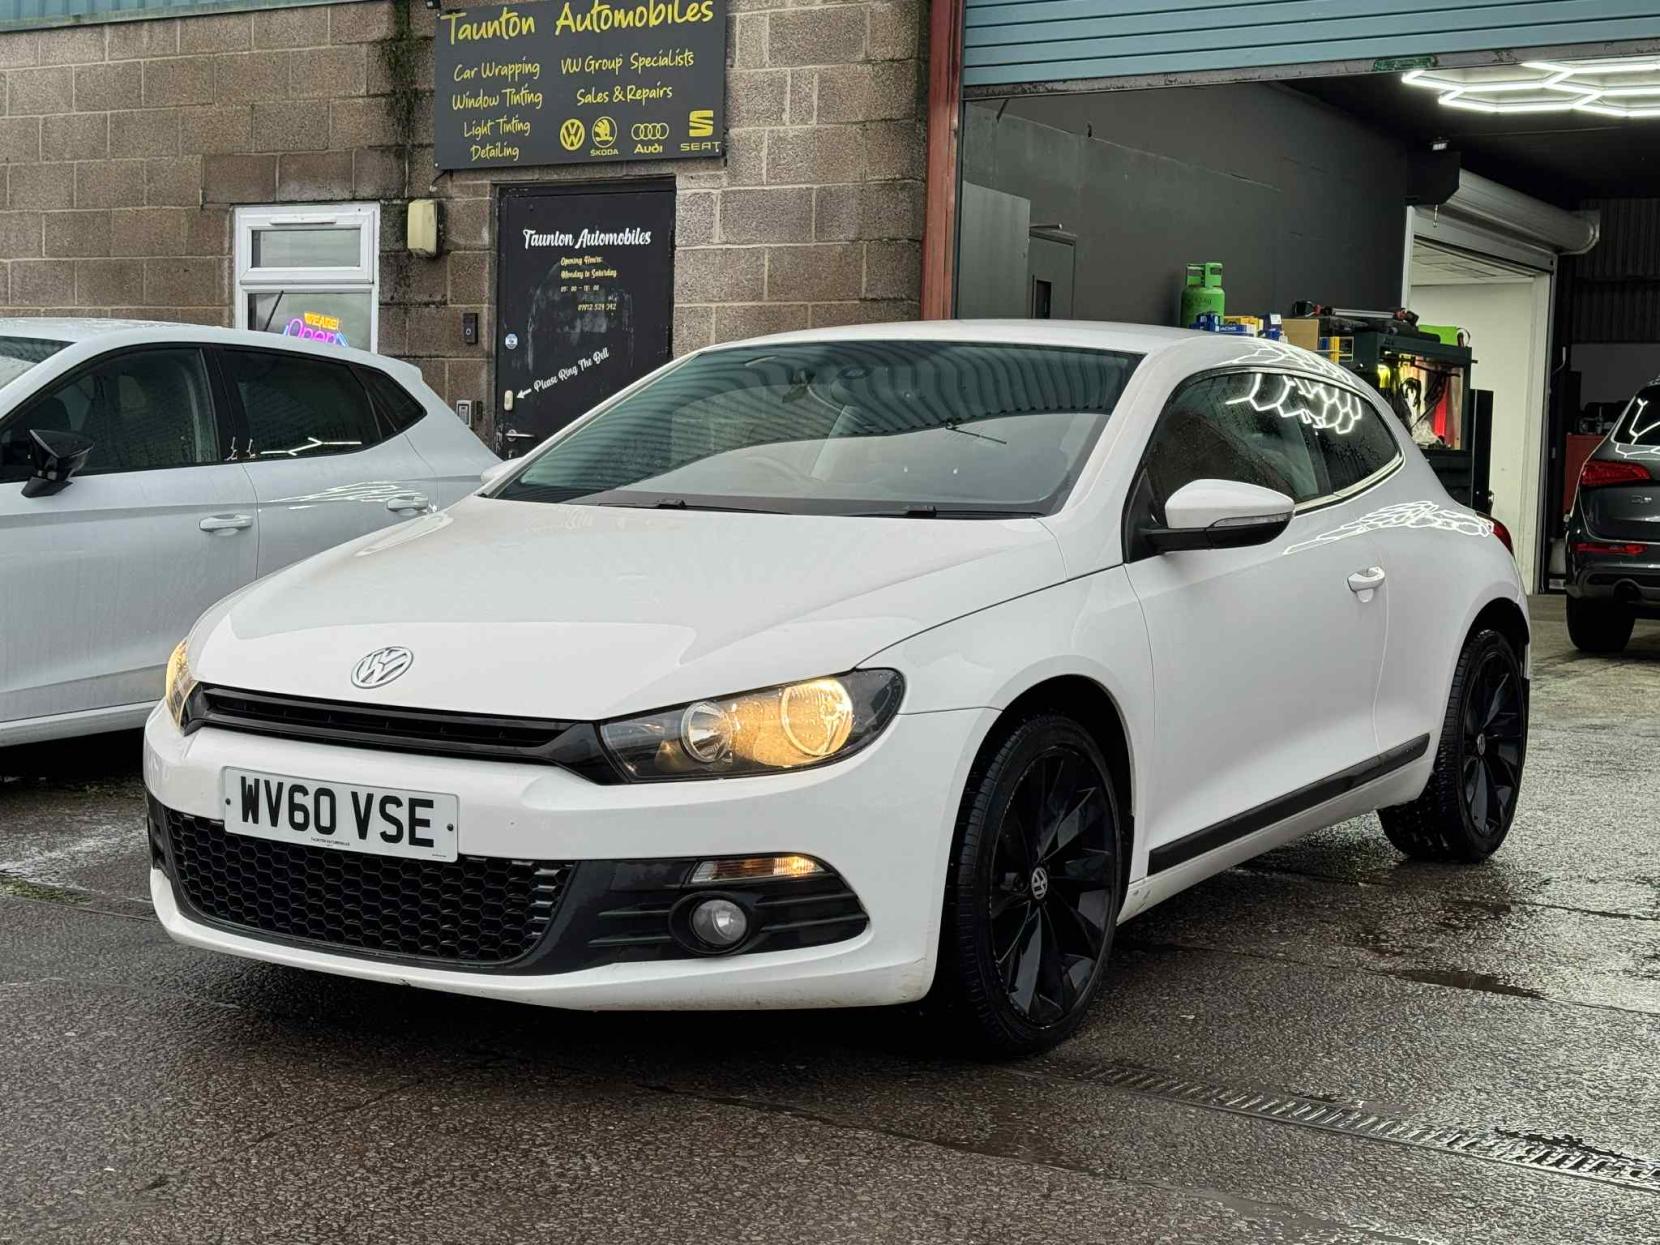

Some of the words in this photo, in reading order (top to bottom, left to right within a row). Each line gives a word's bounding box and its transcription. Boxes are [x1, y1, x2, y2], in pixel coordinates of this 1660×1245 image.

[440, 6, 535, 45] Taunton
[555, 0, 714, 36] Automobiles
[453, 63, 478, 82] Car
[481, 56, 541, 82] Wrapping
[561, 57, 581, 75] VW
[584, 55, 623, 75] Group
[630, 48, 695, 74] Specialists
[452, 88, 500, 111] Window
[501, 83, 543, 109] Tinting
[576, 87, 609, 106] Sales
[612, 85, 625, 103] &
[626, 81, 673, 106] Repairs
[463, 119, 495, 141] Light
[495, 114, 532, 136] Tinting
[470, 141, 520, 162] Detailing
[633, 143, 663, 155] Audi
[680, 141, 721, 152] SEAT
[523, 228, 575, 250] Taunton
[574, 227, 652, 249] Automobiles
[533, 378, 559, 393] Please
[557, 365, 579, 382] Ring
[577, 356, 594, 372] The
[592, 346, 610, 365] Bell
[240, 776, 337, 836] WV60
[350, 790, 435, 848] VSE
